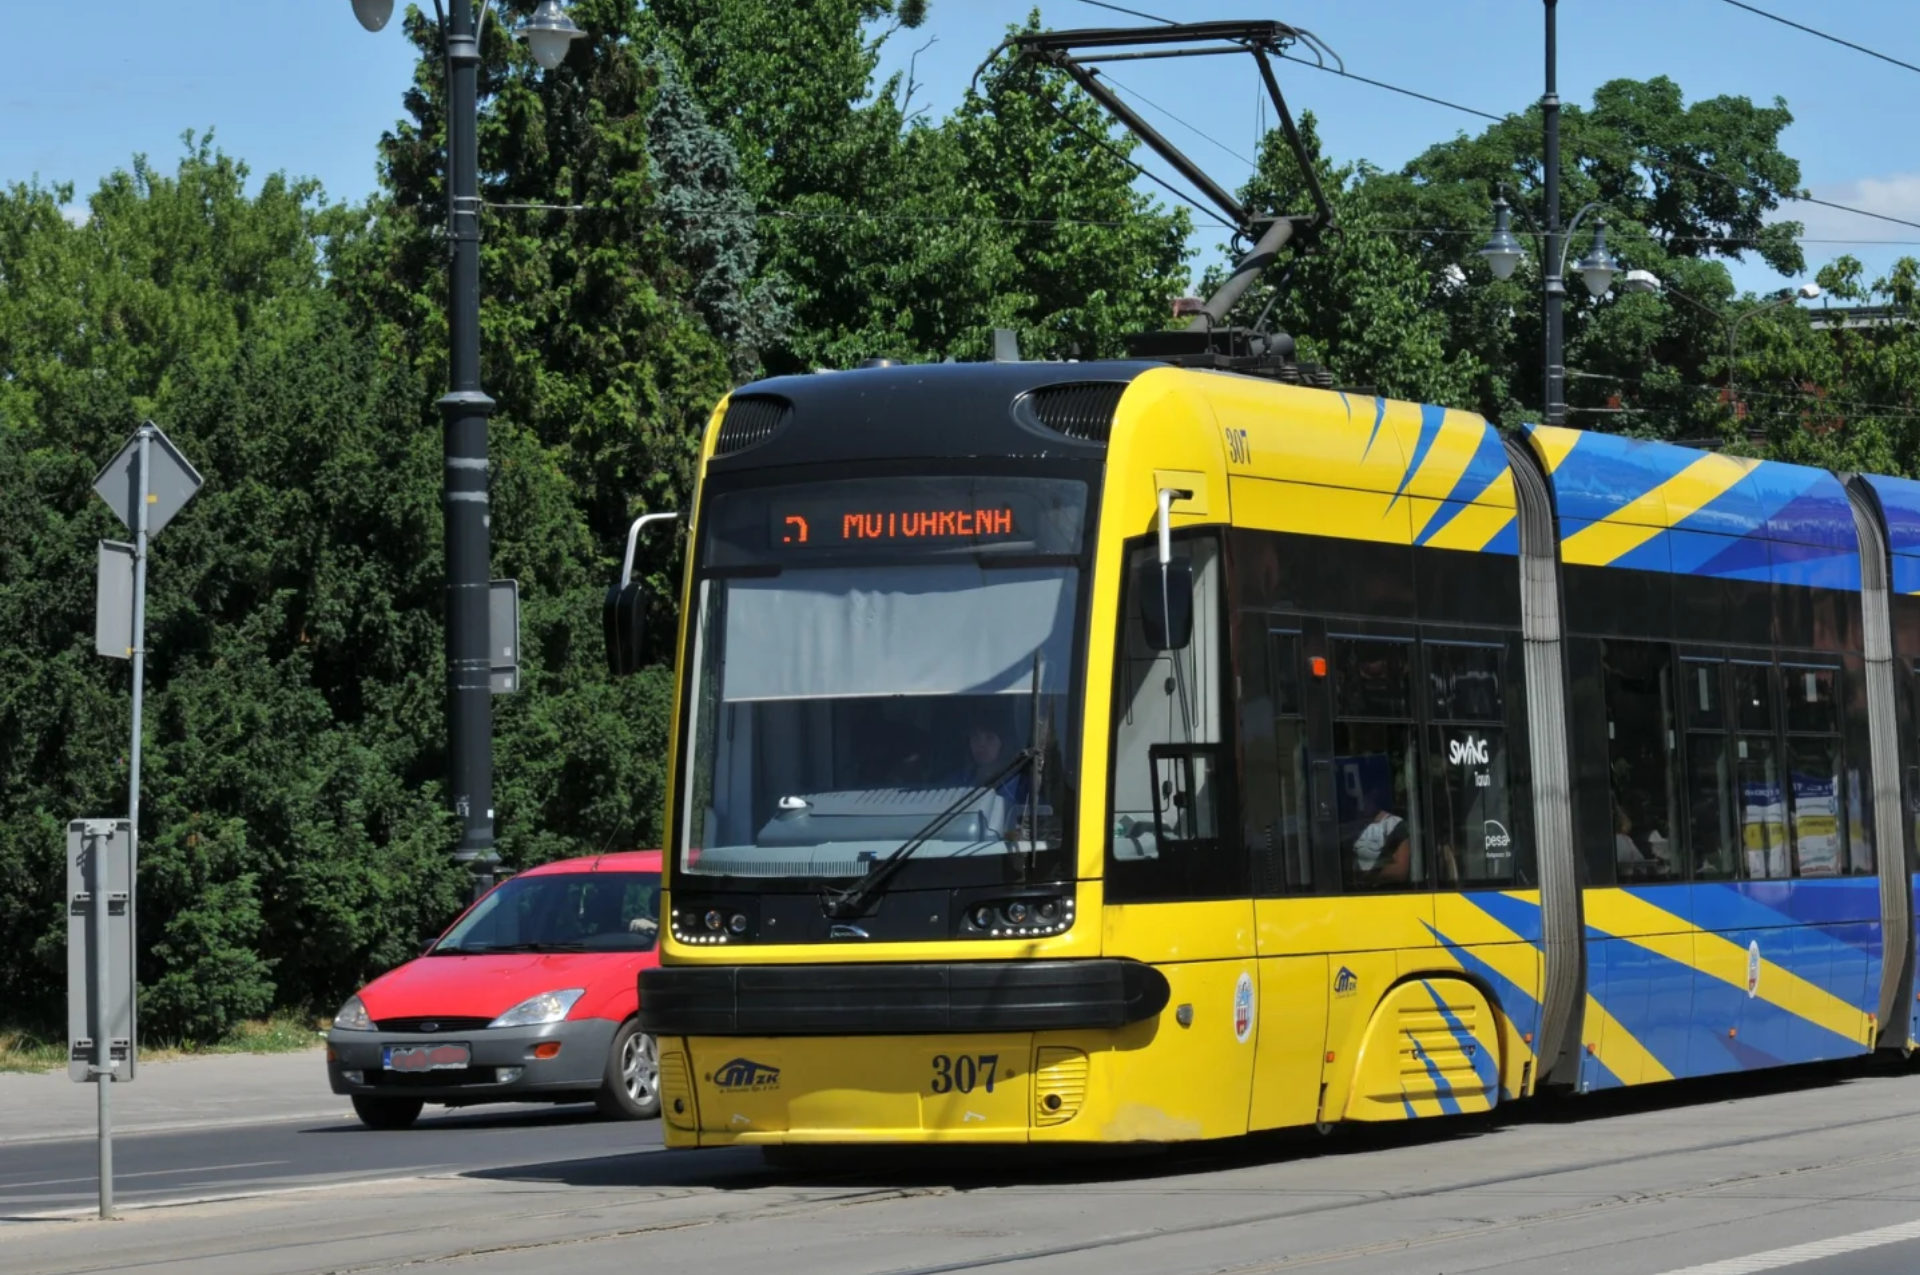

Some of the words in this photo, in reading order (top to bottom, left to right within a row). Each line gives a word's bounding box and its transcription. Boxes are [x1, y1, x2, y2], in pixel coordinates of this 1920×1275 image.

[1225, 427, 1251, 465] 307
[1449, 735, 1489, 765] SWING
[1485, 835, 1508, 850] pesa
[931, 1054, 999, 1094] 307
